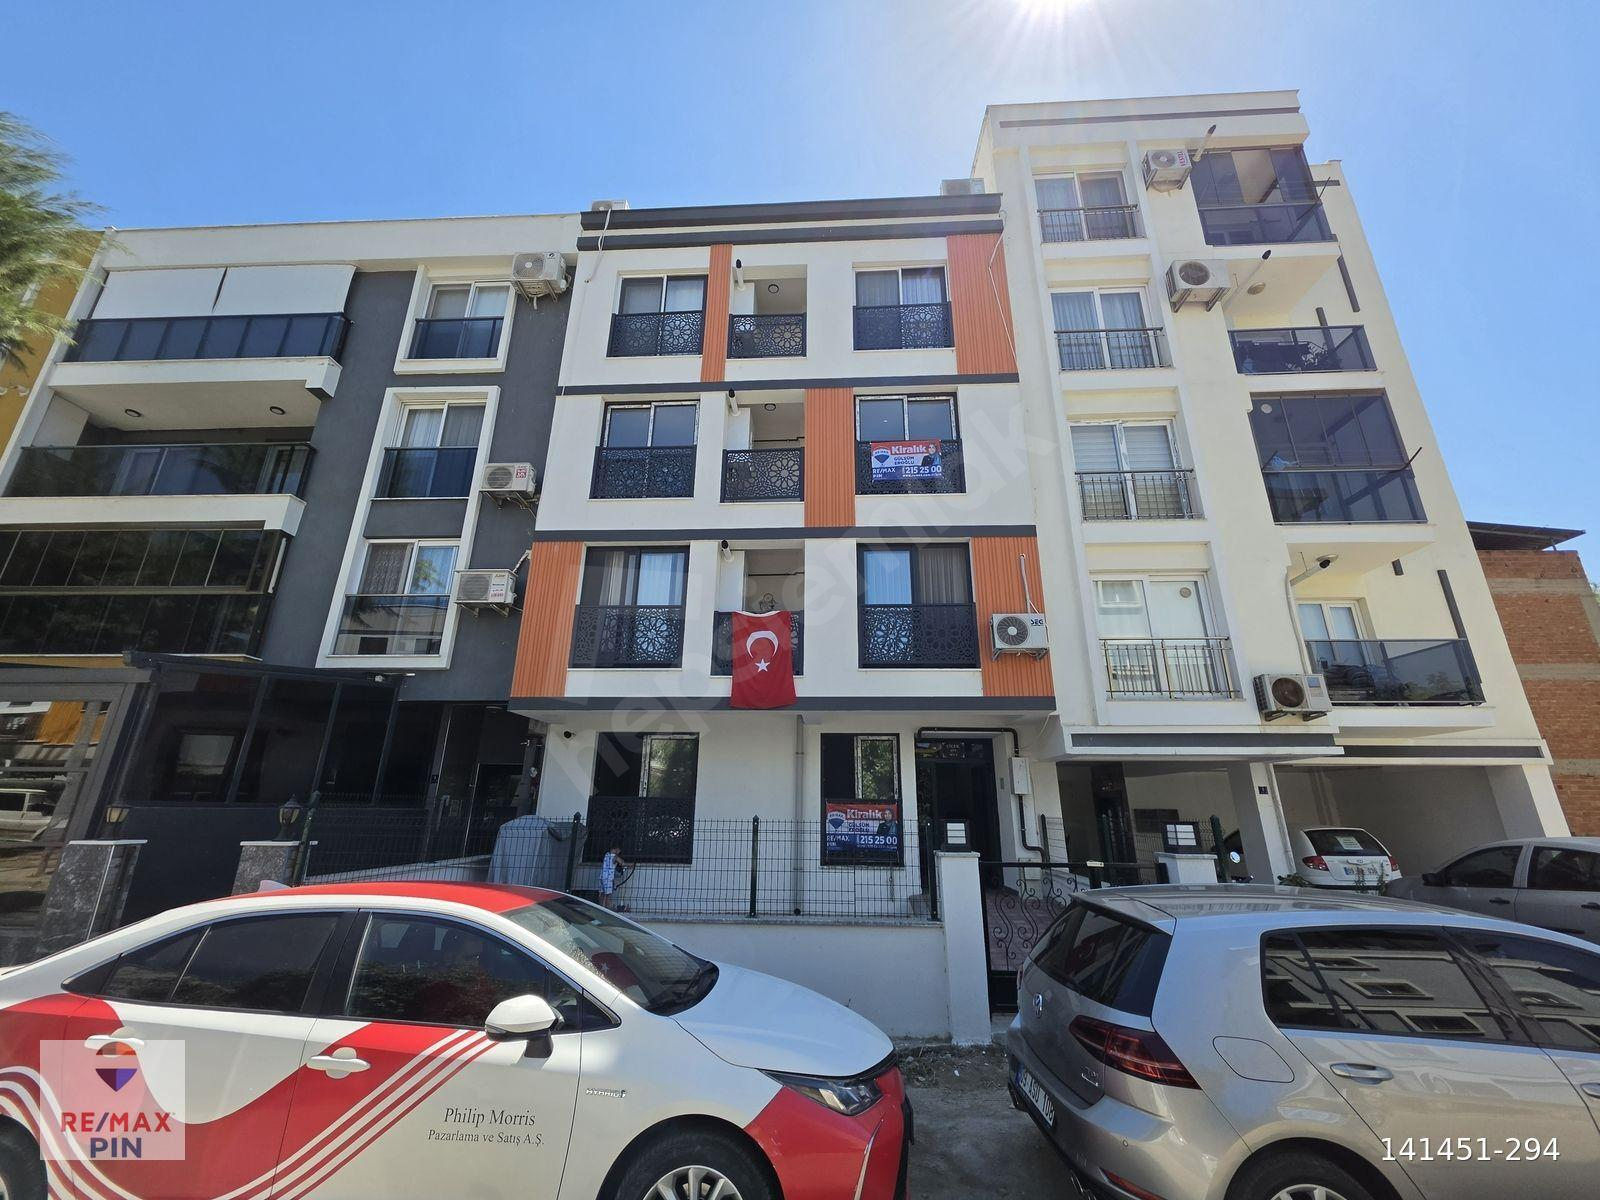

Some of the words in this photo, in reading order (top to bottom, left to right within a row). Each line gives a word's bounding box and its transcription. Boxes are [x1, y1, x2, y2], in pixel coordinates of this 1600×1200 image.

[891, 444, 927, 454] Kiralık
[906, 466, 918, 474] 215
[919, 466, 929, 474] 25
[931, 465, 942, 473] 00
[847, 809, 883, 819] Kiralık
[860, 836, 873, 844] 215
[874, 836, 885, 844] 25
[886, 836, 898, 845] 00
[444, 1107, 485, 1128] Philip
[489, 1109, 536, 1126] Morris
[428, 1129, 480, 1142] Pazarlama
[482, 1134, 494, 1143] ve
[496, 1131, 521, 1146] Satış
